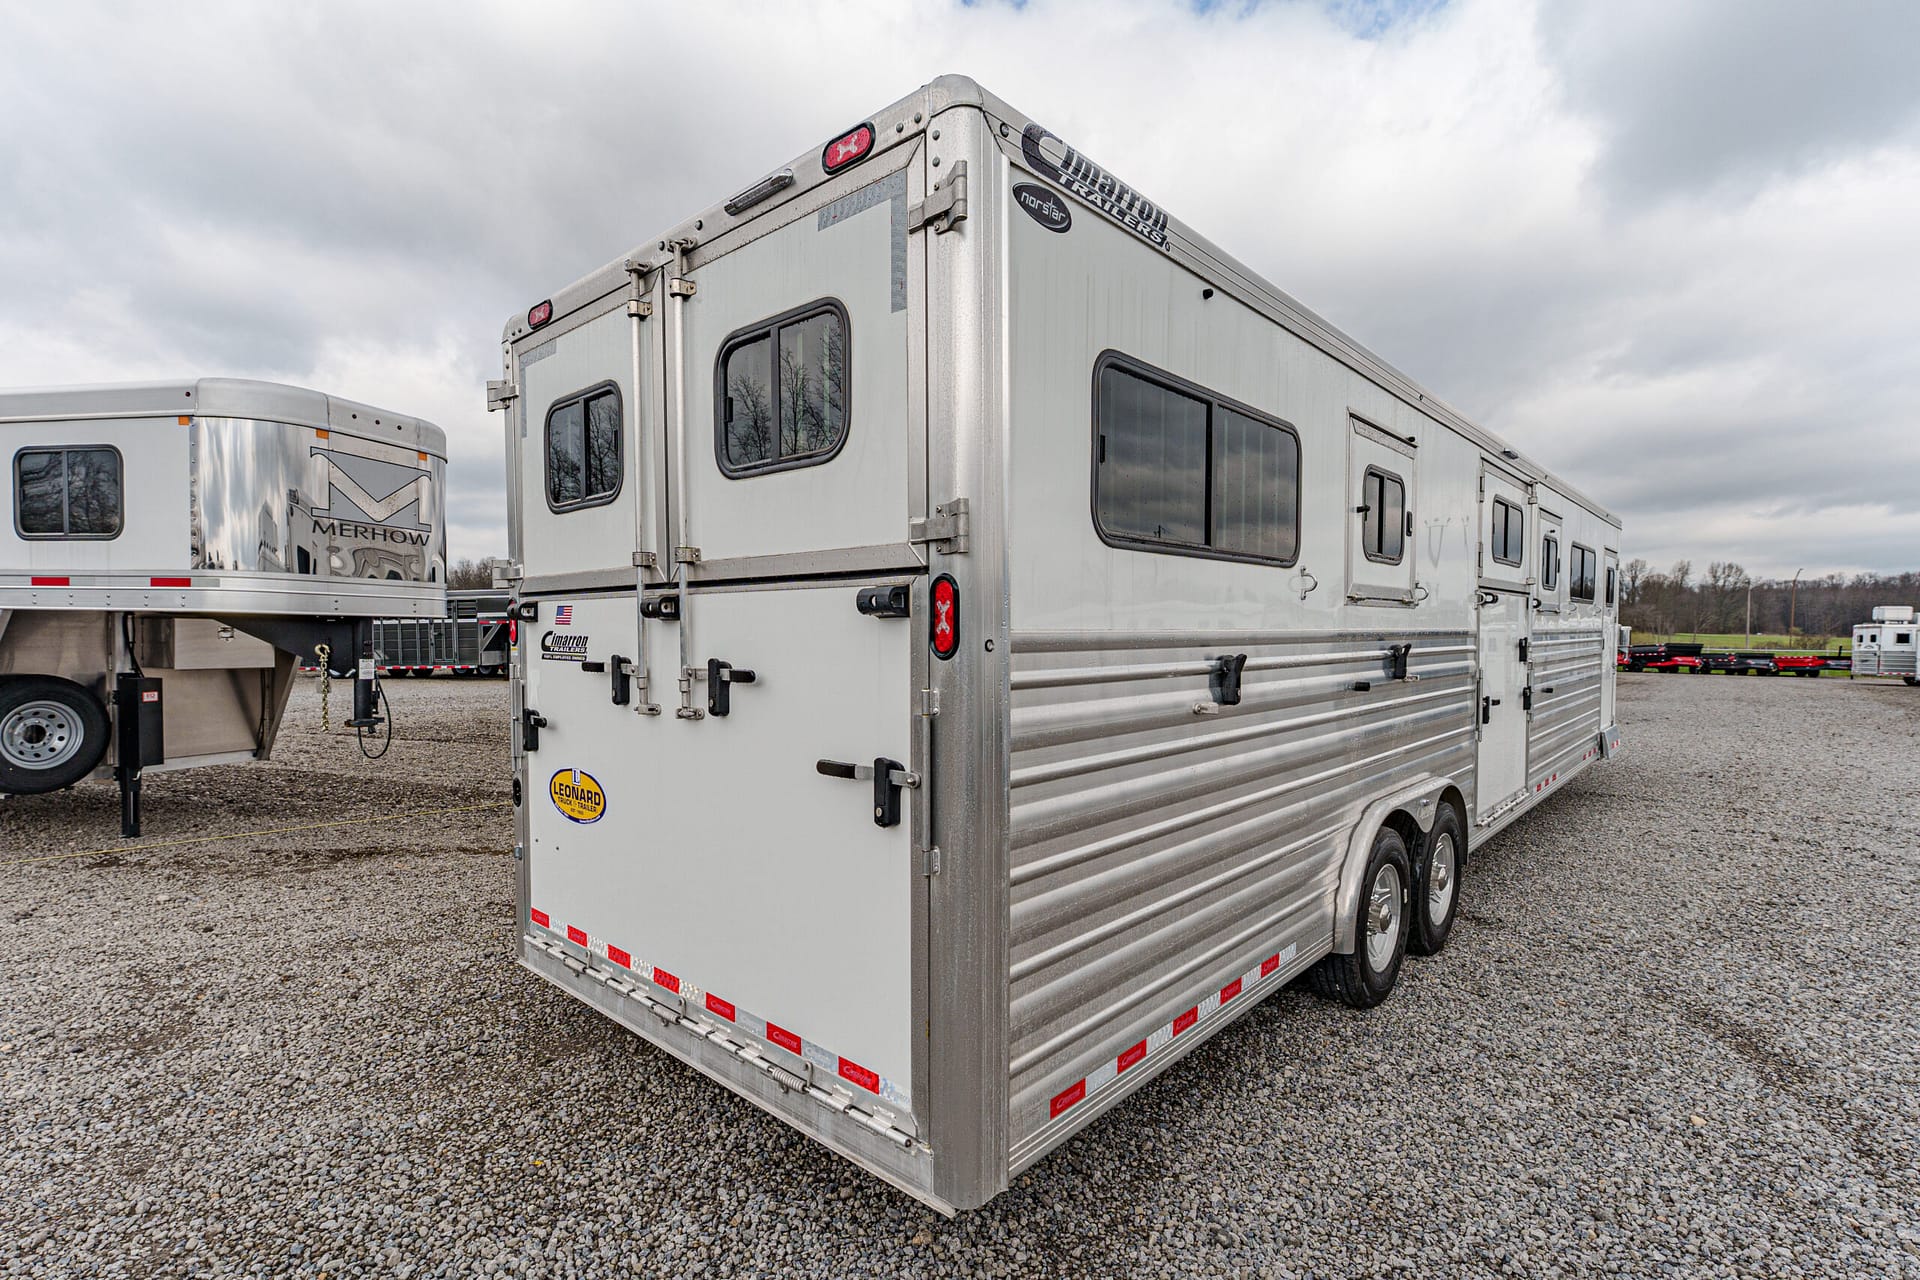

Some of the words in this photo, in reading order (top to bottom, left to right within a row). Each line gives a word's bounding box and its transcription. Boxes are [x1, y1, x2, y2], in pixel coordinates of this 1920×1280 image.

[1021, 122, 1169, 234] Cimarron
[1020, 191, 1066, 222] norstar
[1057, 170, 1164, 244] TRAILERS
[311, 519, 430, 547] MERHOW
[541, 630, 589, 651] Cimarron
[553, 780, 601, 807] LEONARD
[557, 796, 573, 806] TRUCK
[578, 801, 597, 812] TRAILER
